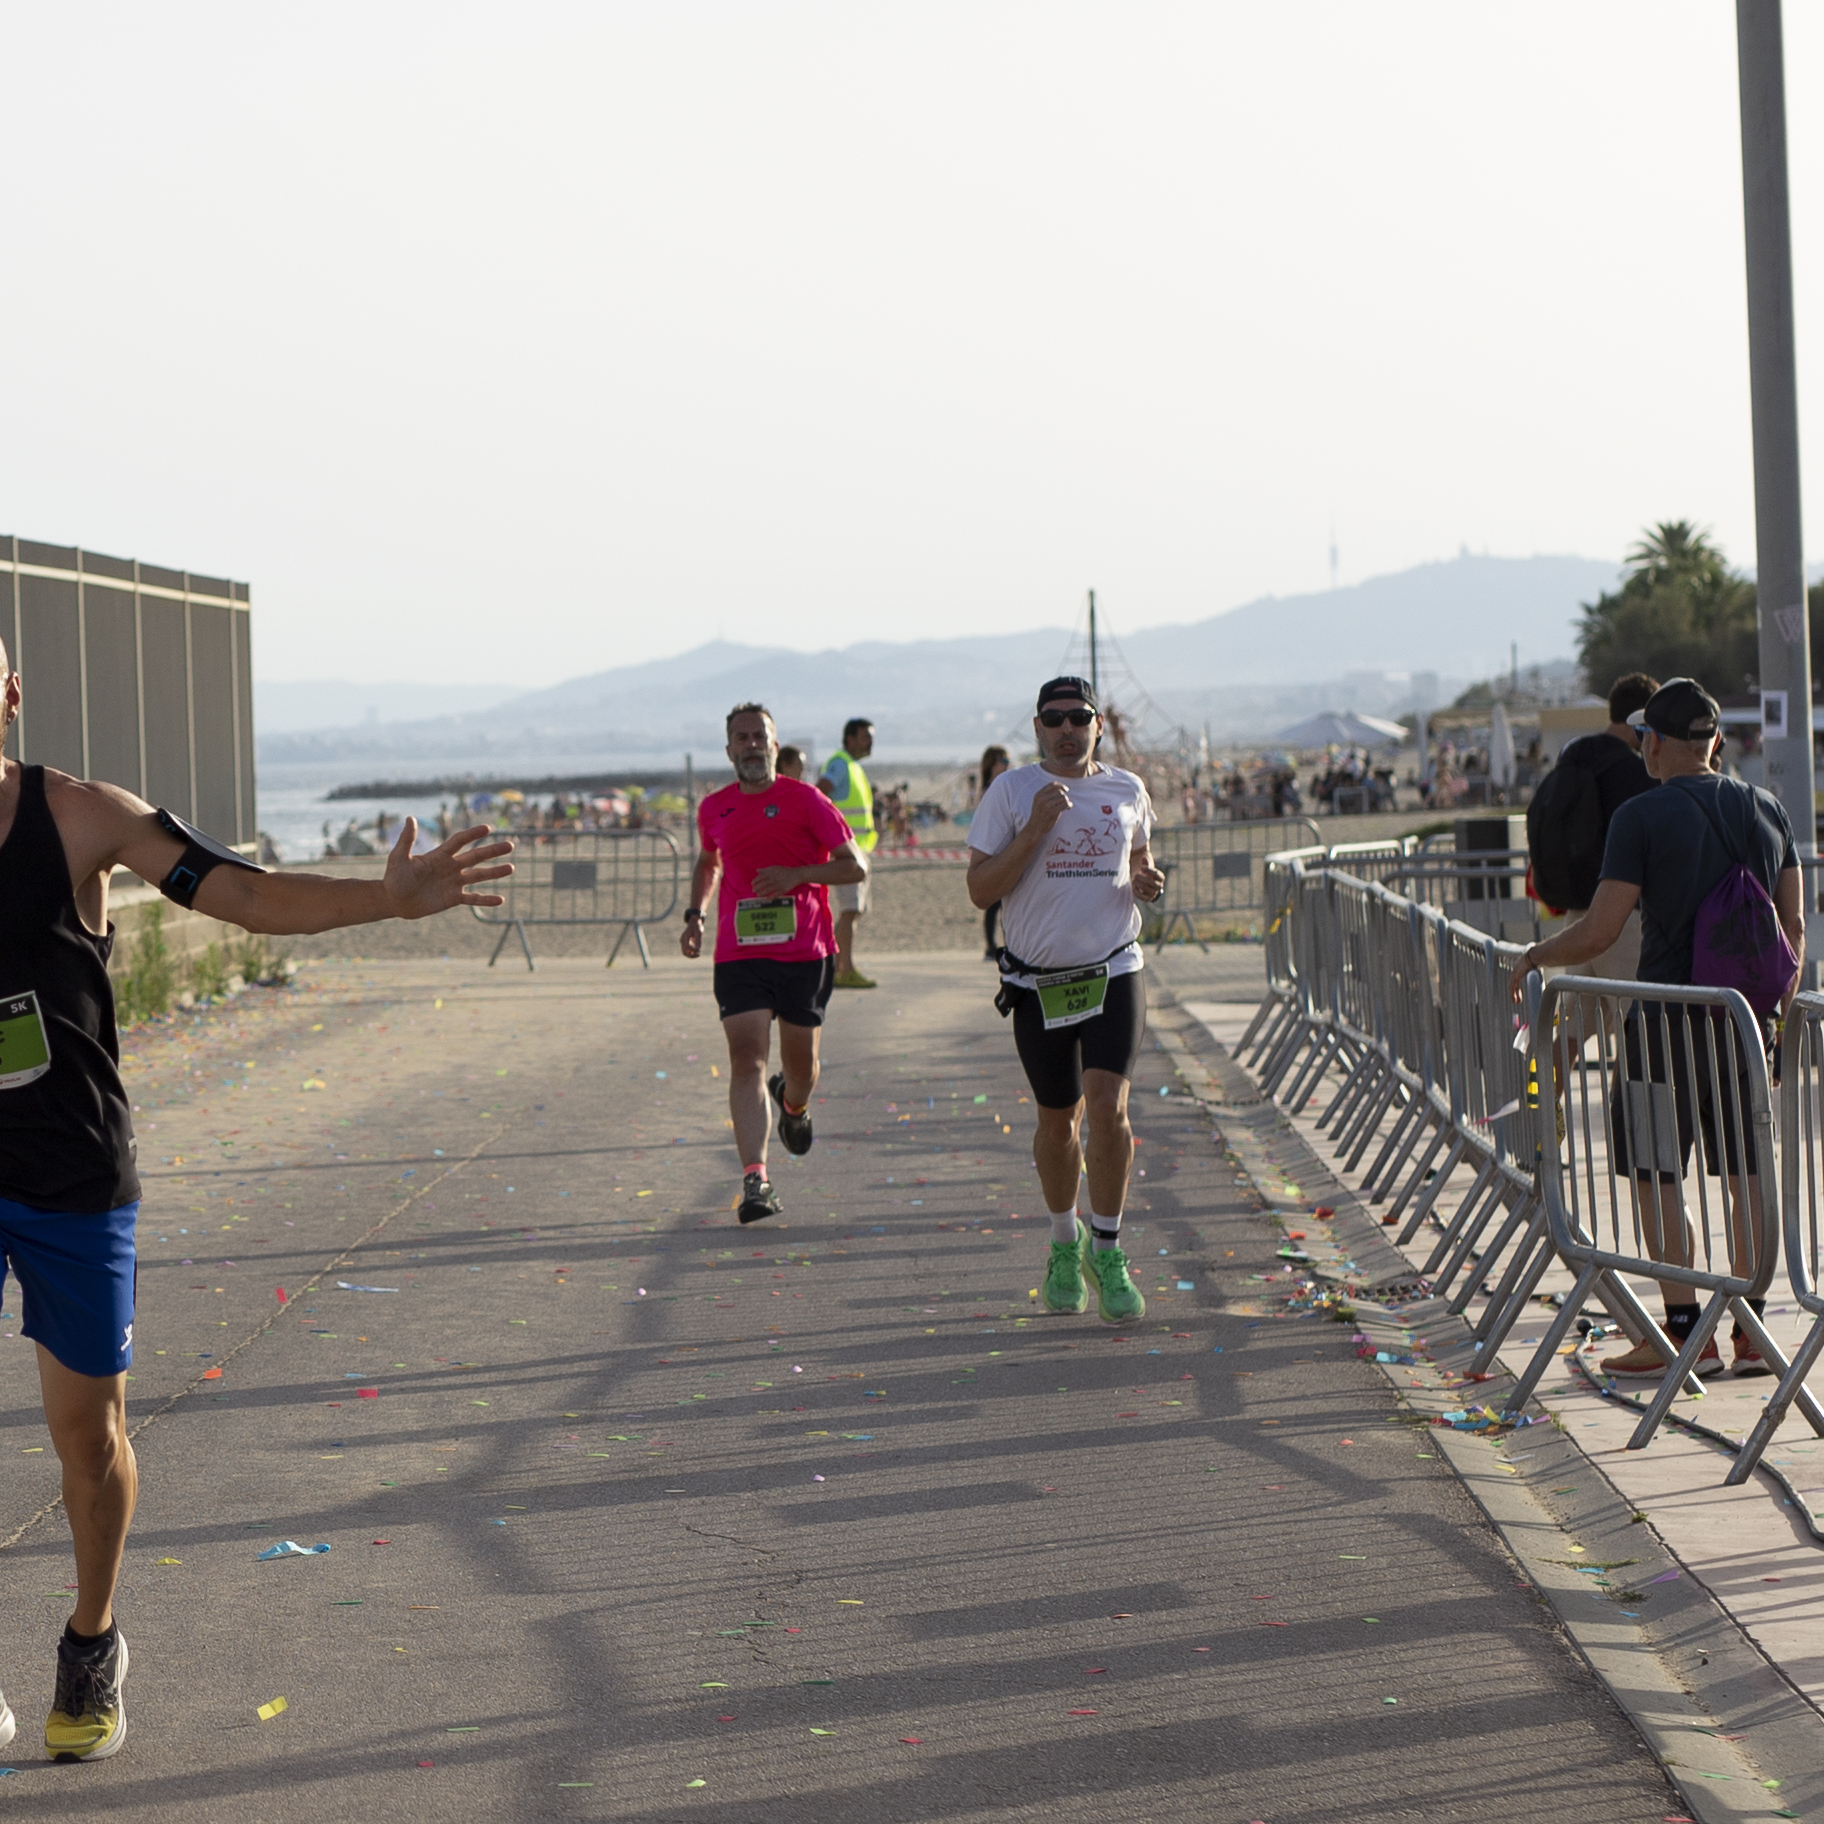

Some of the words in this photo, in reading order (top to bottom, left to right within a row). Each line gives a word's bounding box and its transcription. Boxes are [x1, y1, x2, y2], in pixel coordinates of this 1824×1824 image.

[1045, 859, 1095, 869] Santander
[1063, 985, 1090, 997] XAVI
[10, 1001, 28, 1013] 5K
